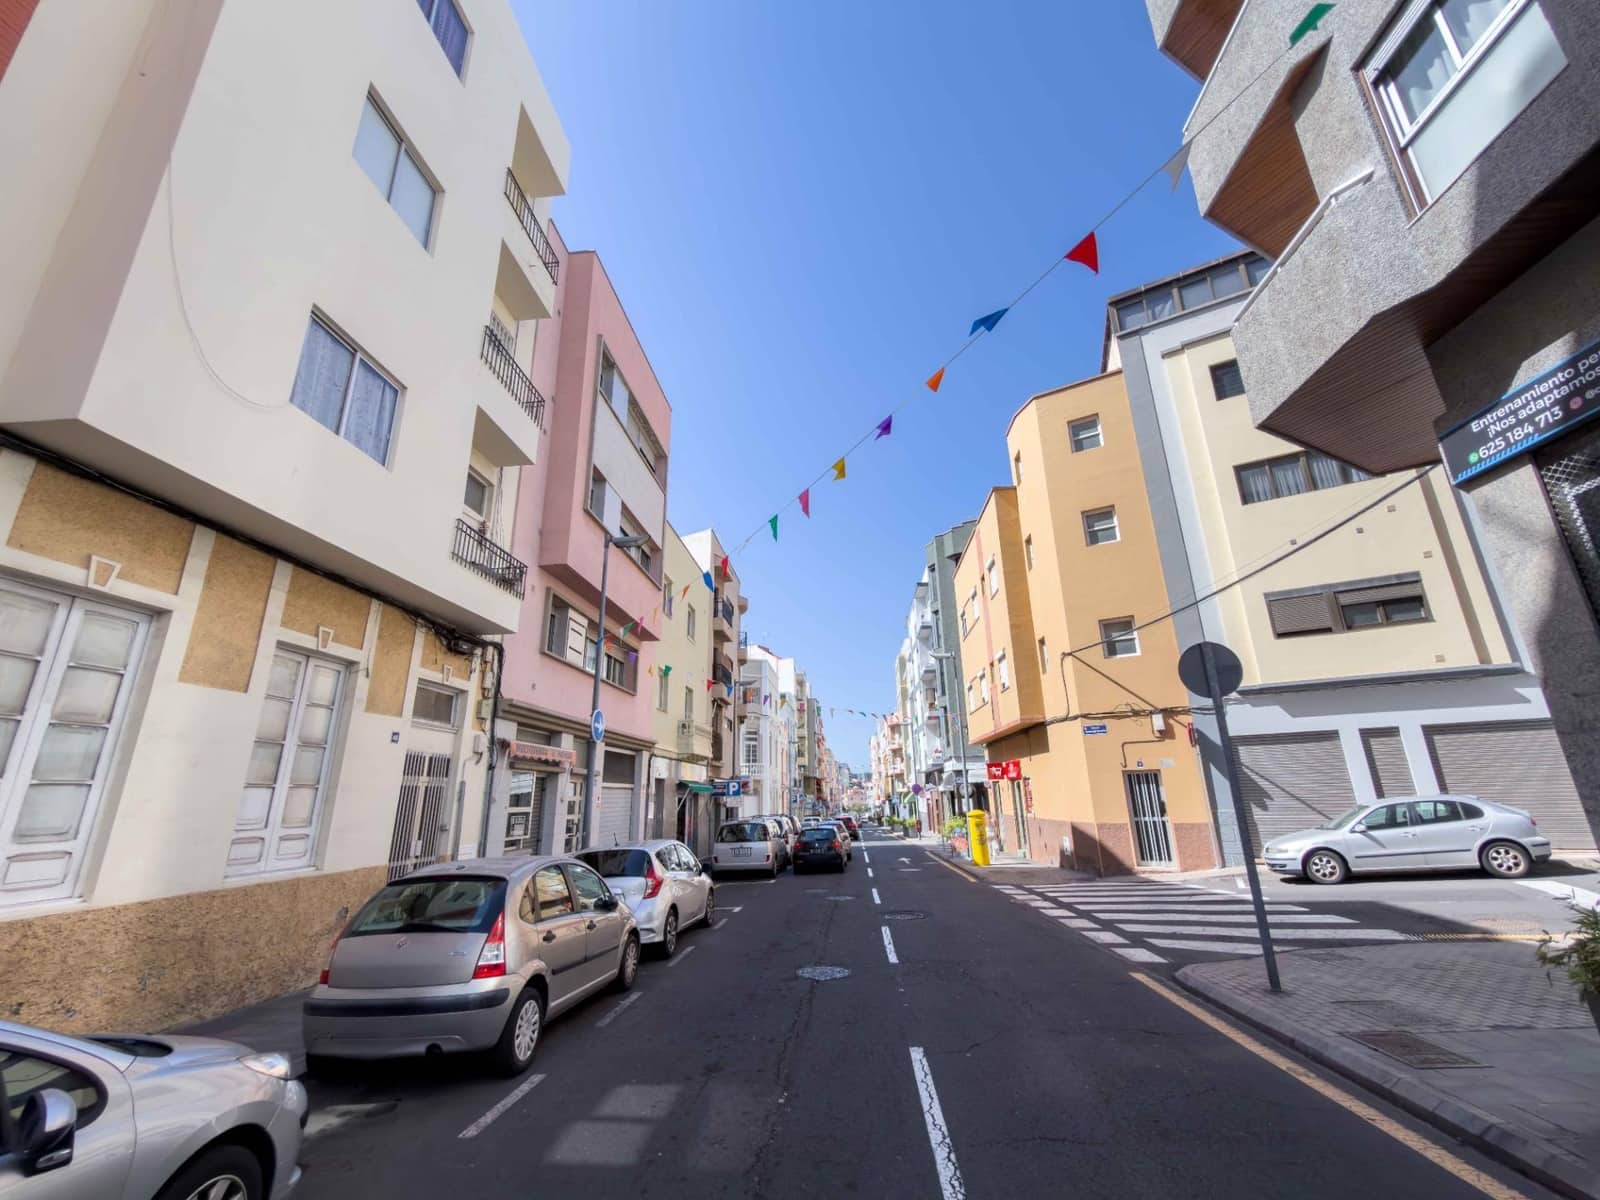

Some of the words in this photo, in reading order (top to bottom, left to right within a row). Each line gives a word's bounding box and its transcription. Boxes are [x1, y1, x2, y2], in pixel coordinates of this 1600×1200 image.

[1471, 368, 1575, 432] Entrenamiento
[1479, 436, 1506, 458] 625
[1505, 422, 1535, 443] 184
[1535, 405, 1563, 428] 713
[1487, 415, 1516, 438] ¡Nos
[729, 782, 739, 795] P
